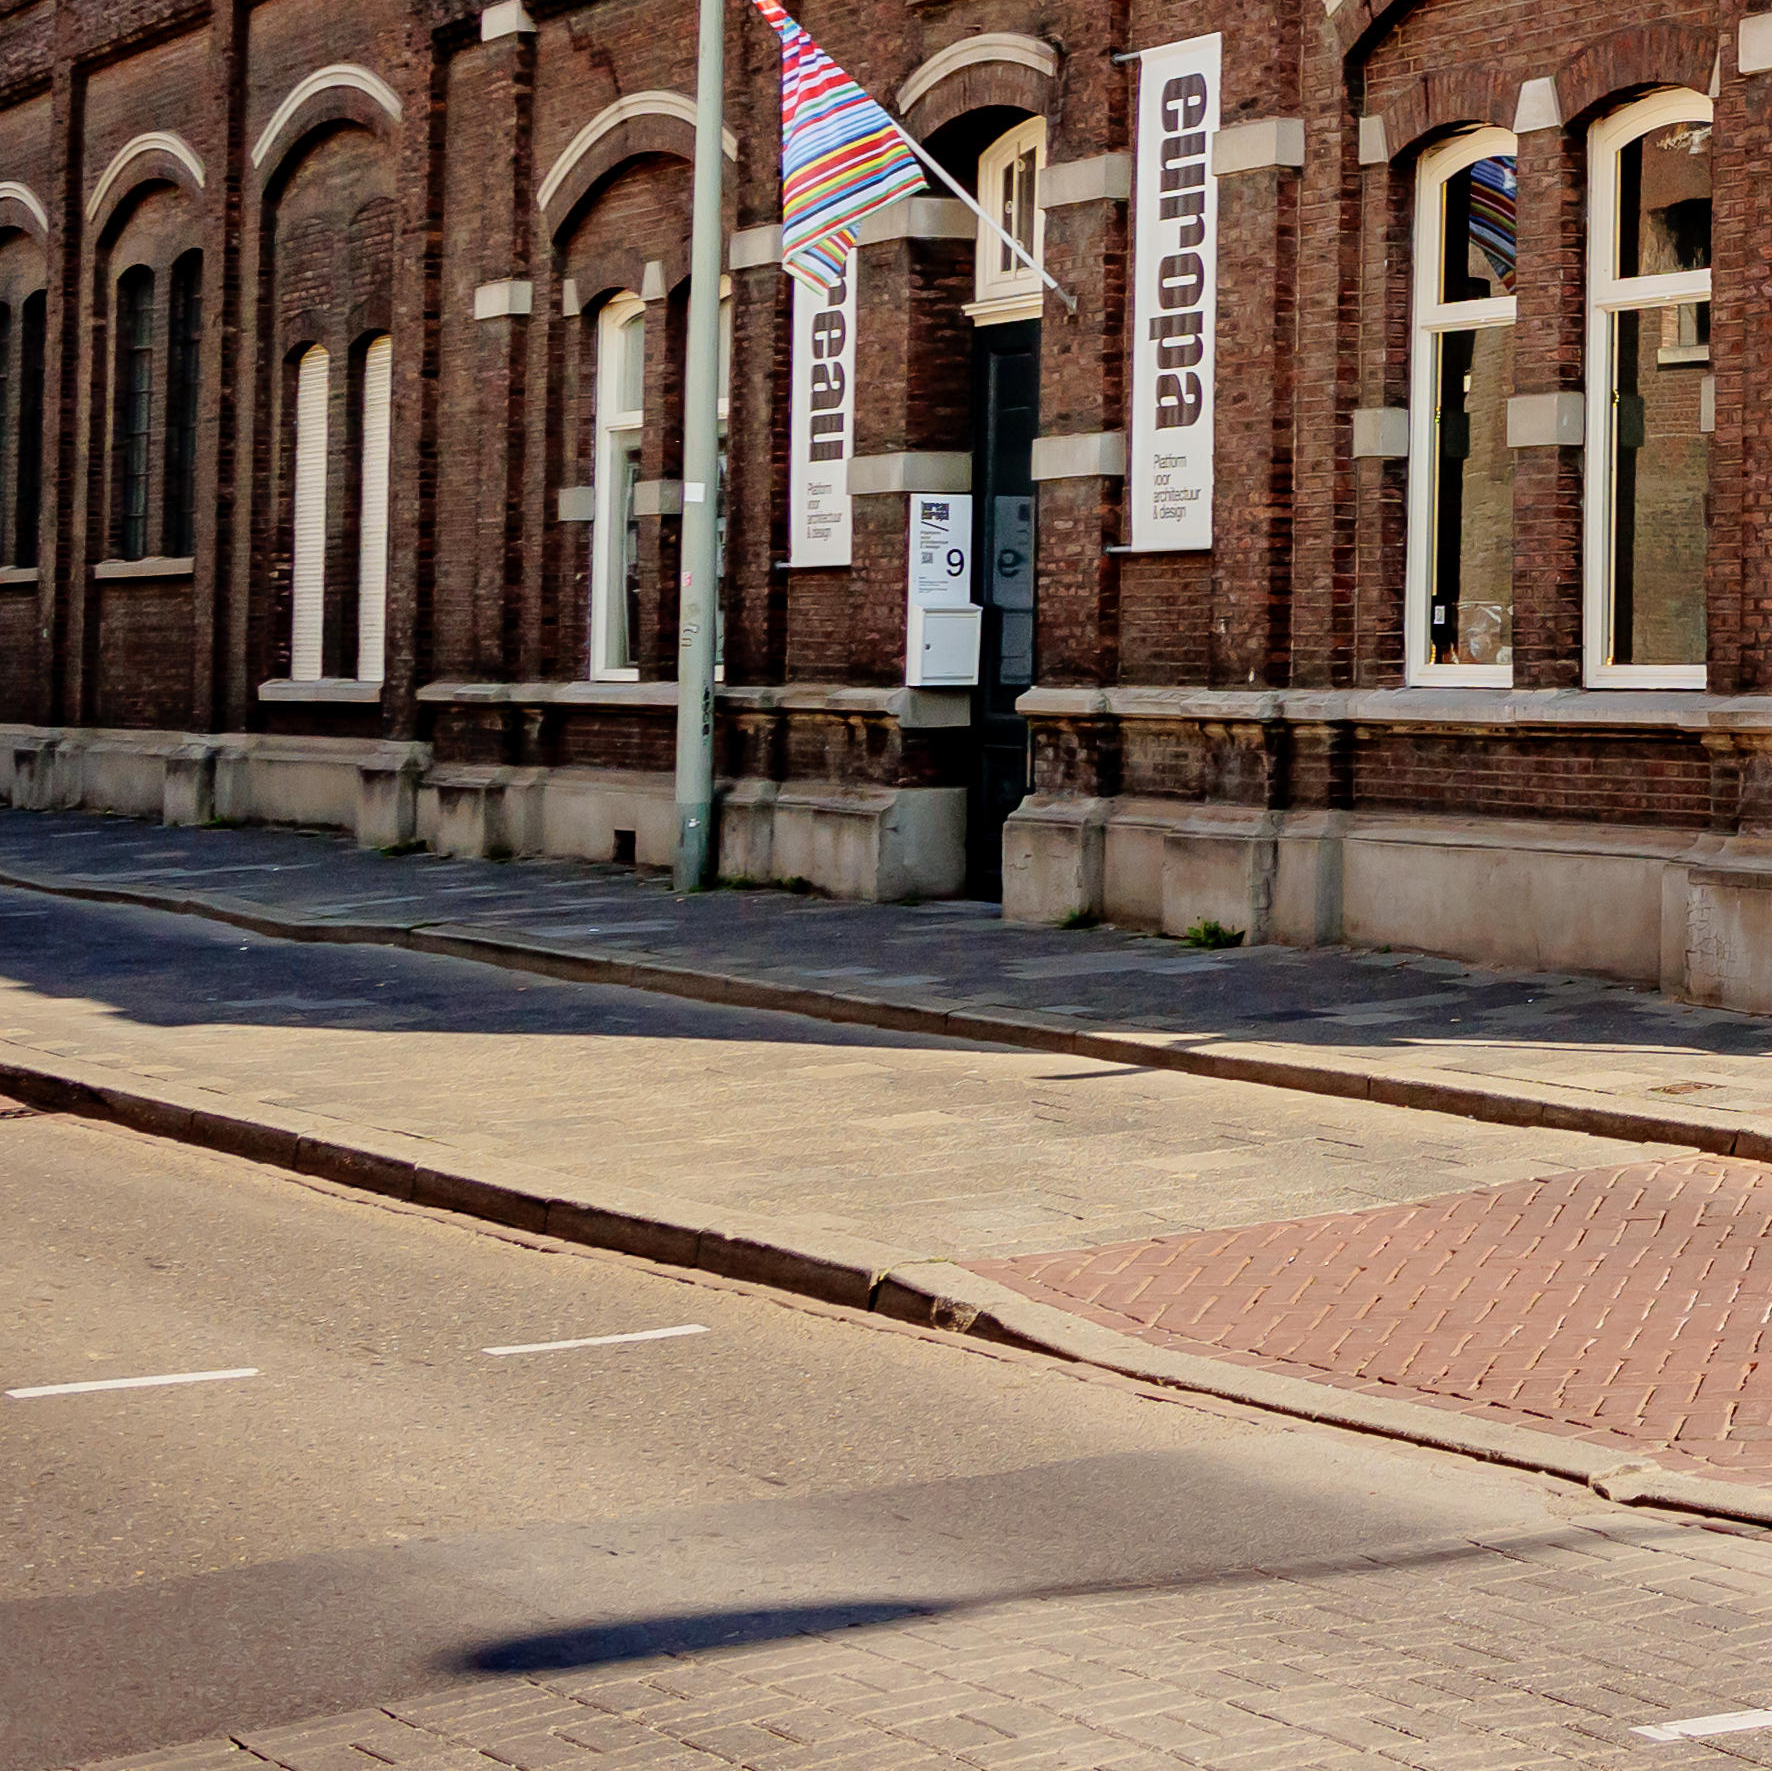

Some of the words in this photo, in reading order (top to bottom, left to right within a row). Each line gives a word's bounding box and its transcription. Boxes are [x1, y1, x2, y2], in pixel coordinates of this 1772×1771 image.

[1148, 73, 1208, 432] europa
[1153, 453, 1187, 469] Platform
[1153, 473, 1172, 486] voor
[1153, 487, 1202, 503] architectuur
[1159, 503, 1187, 522] design
[946, 548, 965, 577] 9
